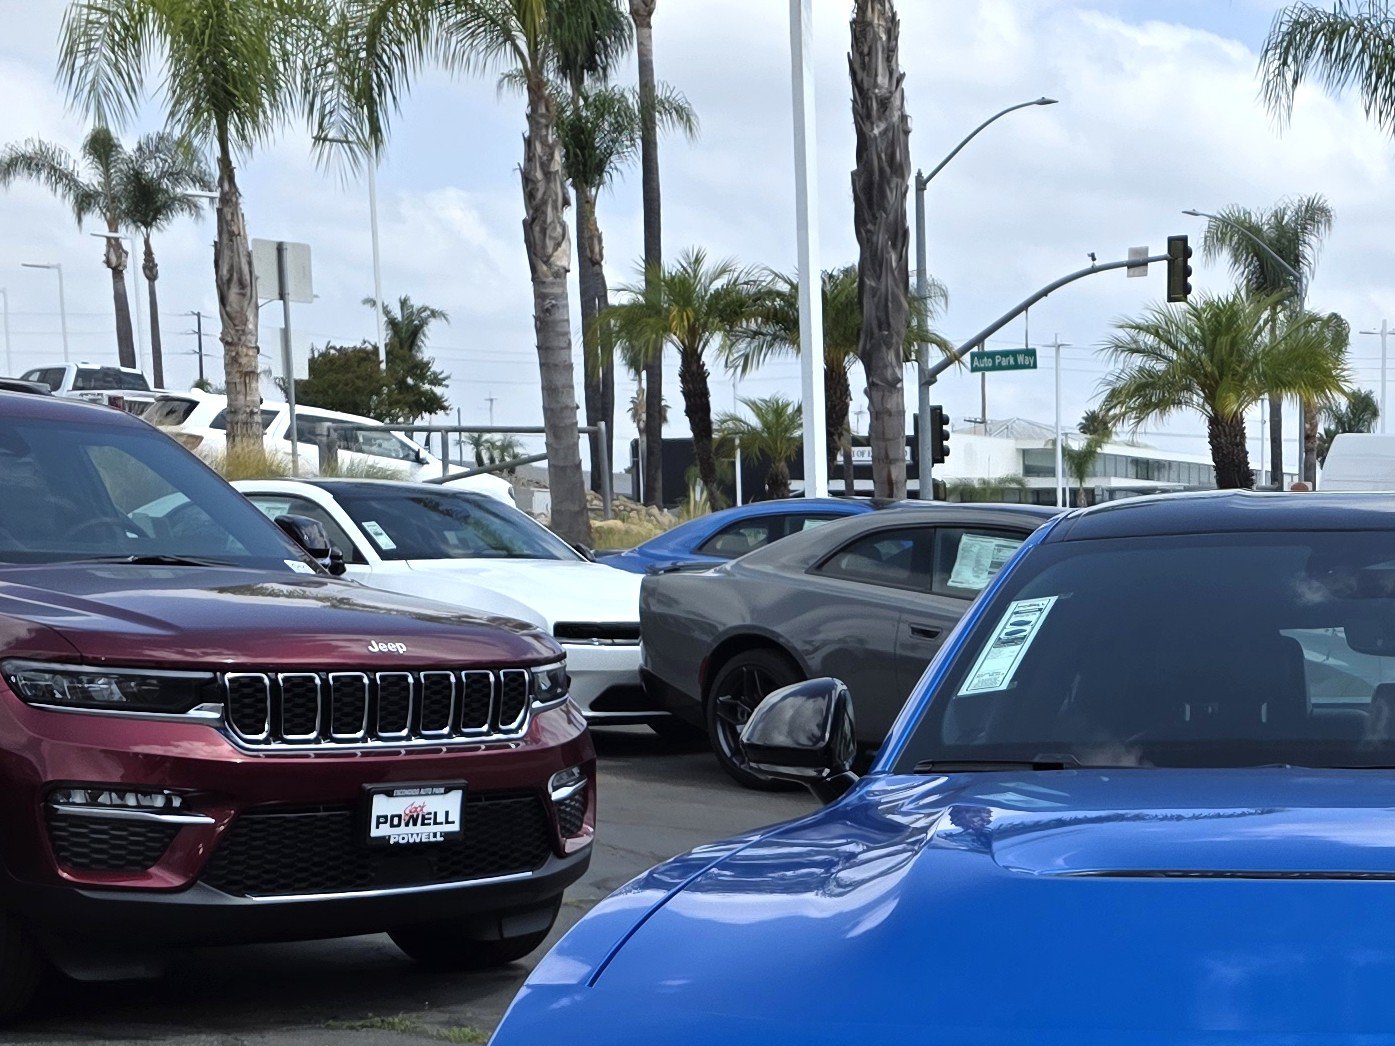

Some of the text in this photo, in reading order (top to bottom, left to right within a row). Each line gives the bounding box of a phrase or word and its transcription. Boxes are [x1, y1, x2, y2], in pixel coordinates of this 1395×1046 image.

[973, 353, 1035, 367] Auto Park Way
[368, 640, 407, 654] Jeep
[375, 810, 456, 830] POWELL
[389, 831, 445, 845] POWELL
